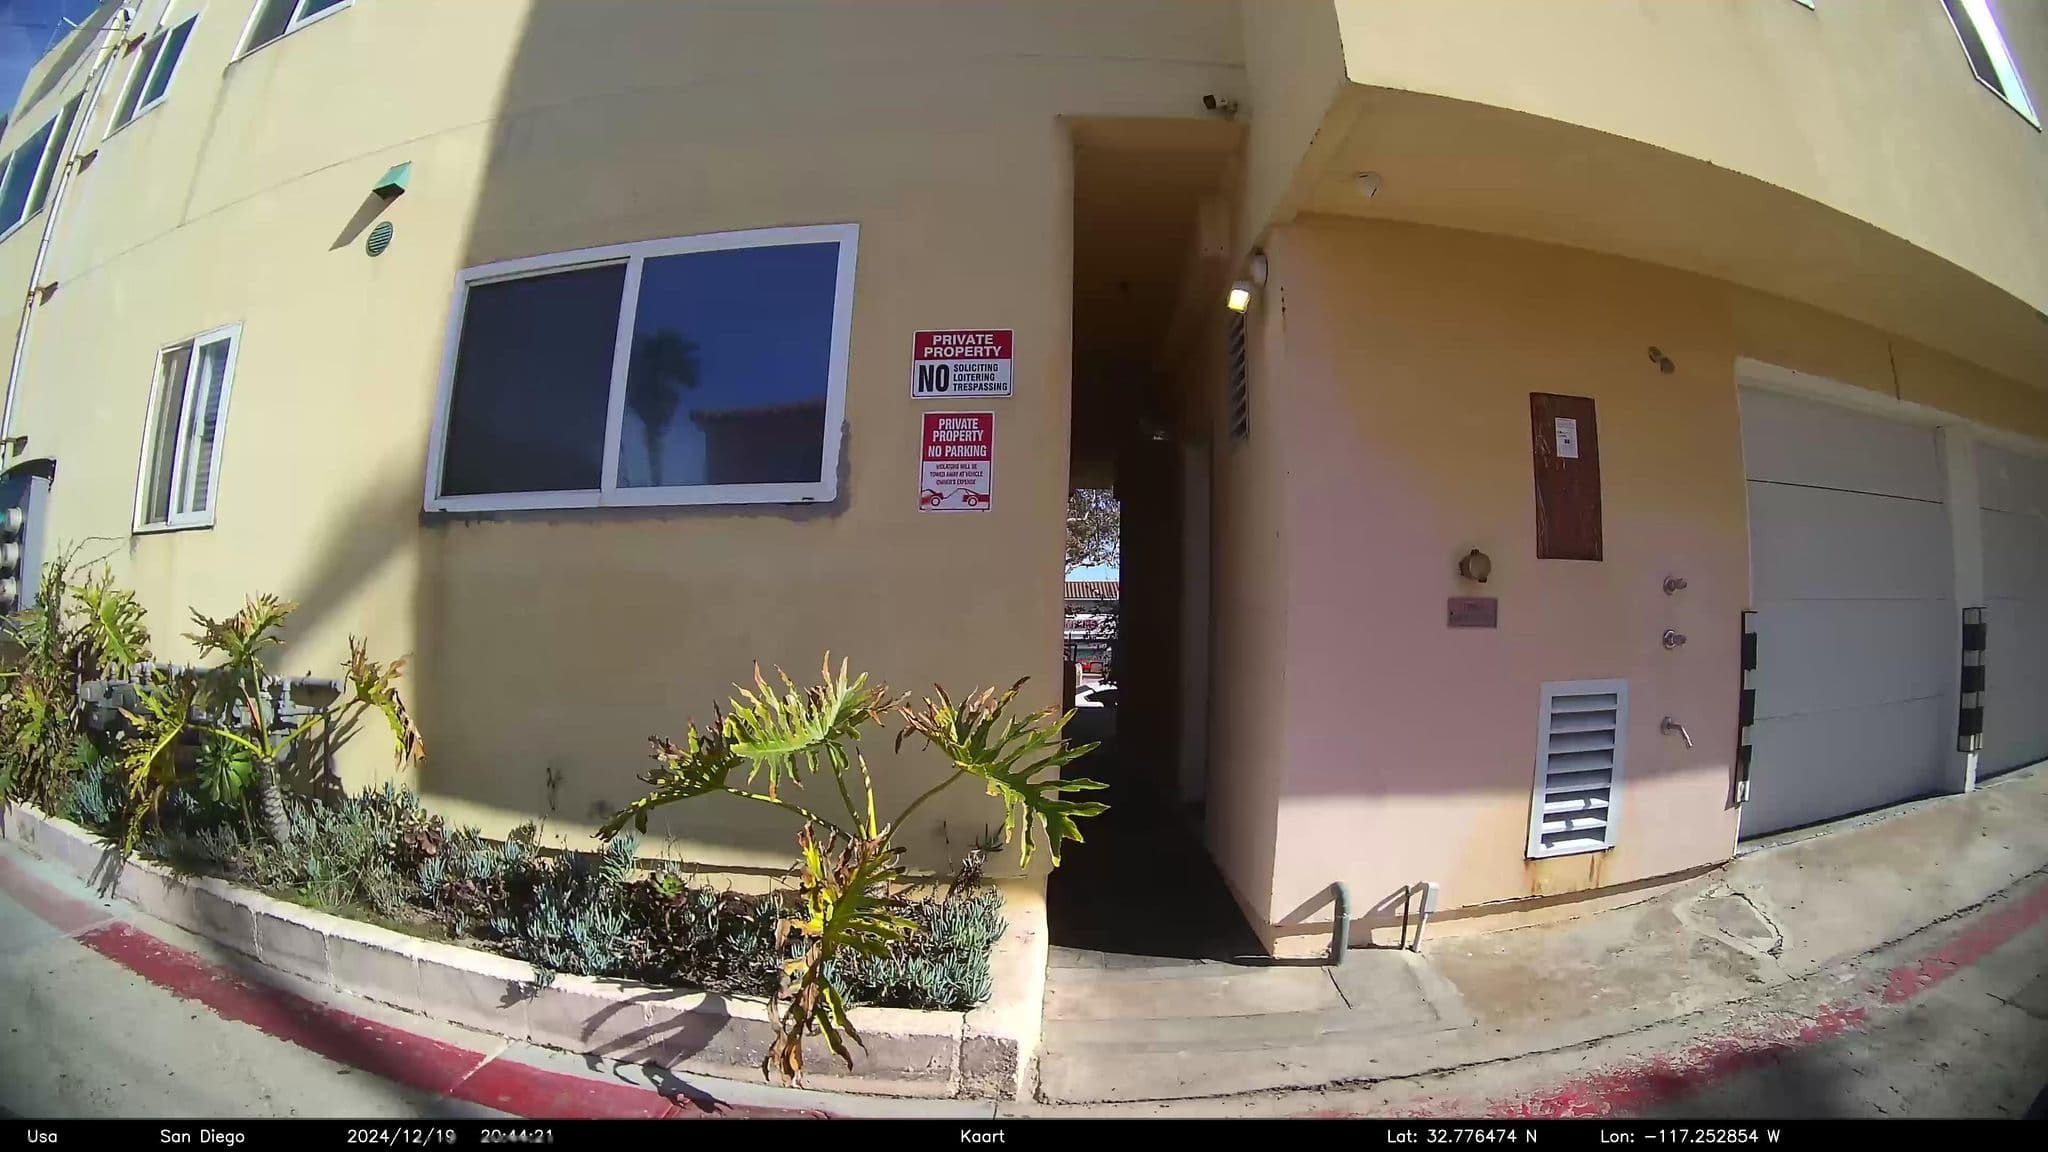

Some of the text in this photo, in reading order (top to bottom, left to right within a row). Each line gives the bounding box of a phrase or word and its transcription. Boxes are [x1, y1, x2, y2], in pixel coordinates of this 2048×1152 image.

[932, 334, 994, 346] PRIVATE
[924, 345, 1002, 358] PROPERTY
[953, 363, 999, 372] SOLICITING
[918, 364, 950, 393] NO
[953, 373, 995, 382] LOITERING
[953, 382, 1008, 392] TRESPASSING
[938, 417, 979, 430] PRIVATE
[932, 429, 985, 442] PROPERTY
[928, 445, 988, 457] NO PARKING
